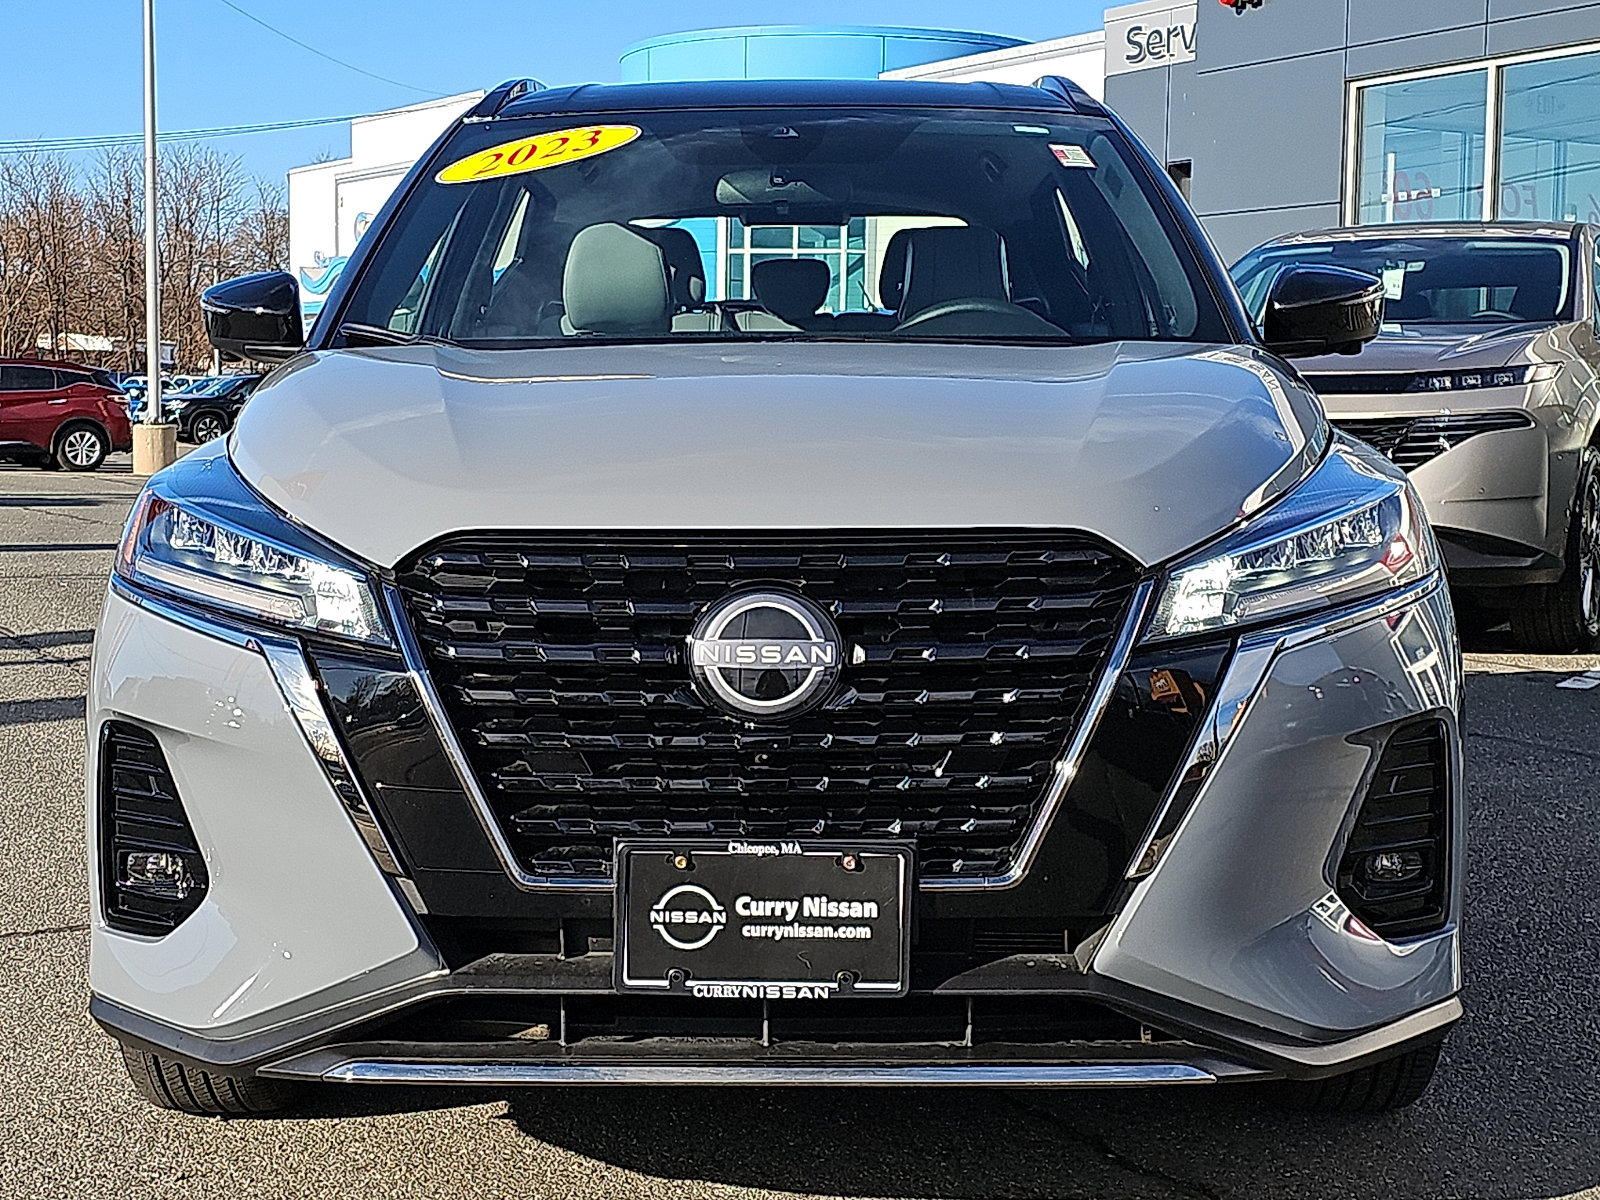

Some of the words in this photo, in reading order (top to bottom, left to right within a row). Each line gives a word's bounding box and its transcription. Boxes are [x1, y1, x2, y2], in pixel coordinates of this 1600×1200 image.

[1125, 23, 1197, 60] Serv
[472, 130, 603, 177] 2023
[699, 645, 832, 664] NISSAN
[728, 841, 779, 857] Chicopee,
[780, 840, 802, 854] MA
[650, 911, 726, 924] NISSAN
[735, 896, 799, 921] Curry
[803, 897, 879, 918] Nissan
[742, 923, 872, 941] currynissan.com
